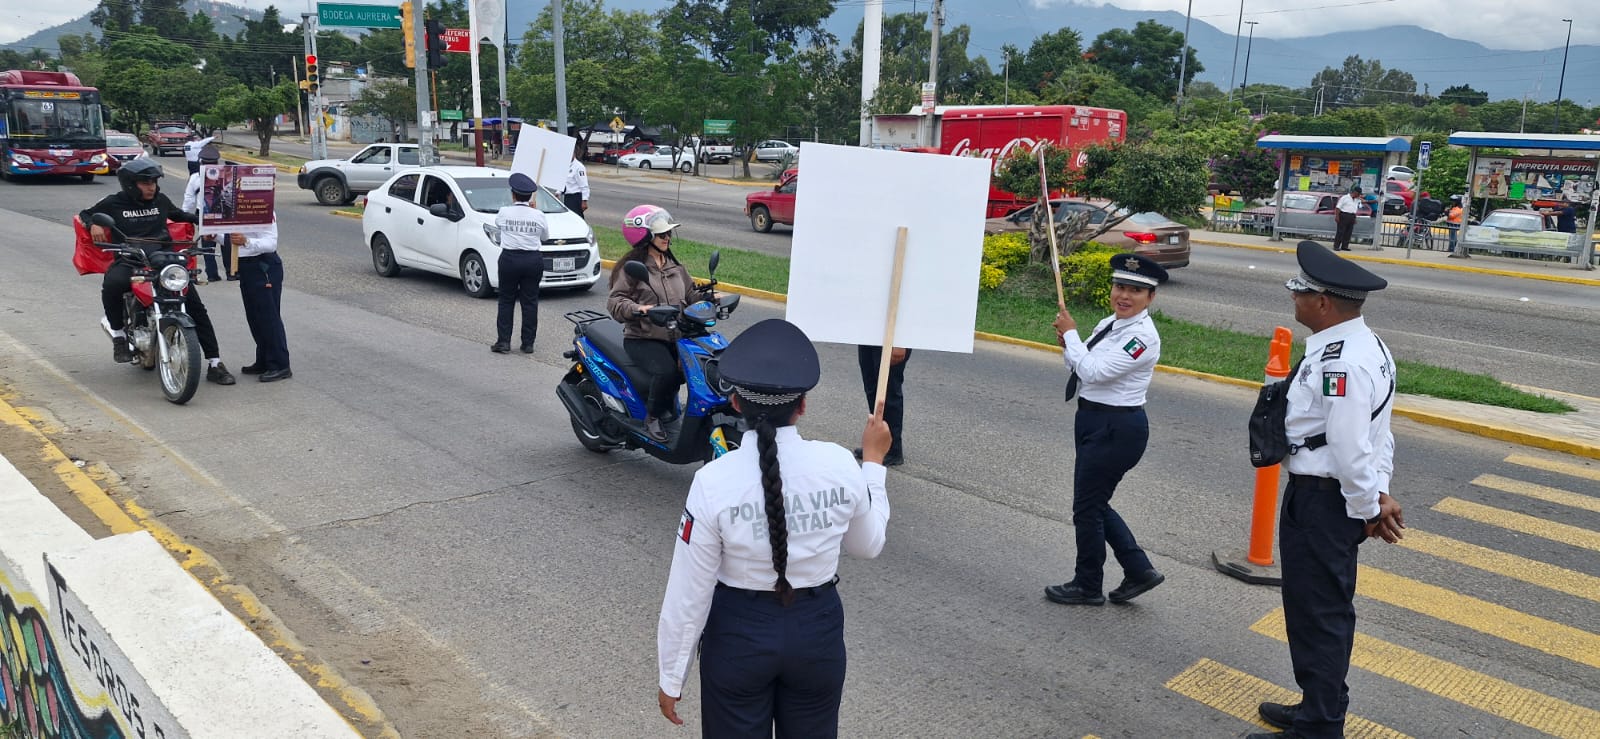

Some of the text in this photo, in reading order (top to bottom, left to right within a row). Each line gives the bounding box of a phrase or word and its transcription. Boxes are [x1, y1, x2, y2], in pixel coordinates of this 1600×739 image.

[322, 10, 392, 22] BODEGA AURRERA
[1514, 162, 1560, 171] IMPRENTA
[122, 207, 161, 218] CHALLENGE
[729, 487, 851, 525] POLÍA VIAL
[752, 511, 833, 540] EATAL
[47, 560, 146, 739] TESOROS
